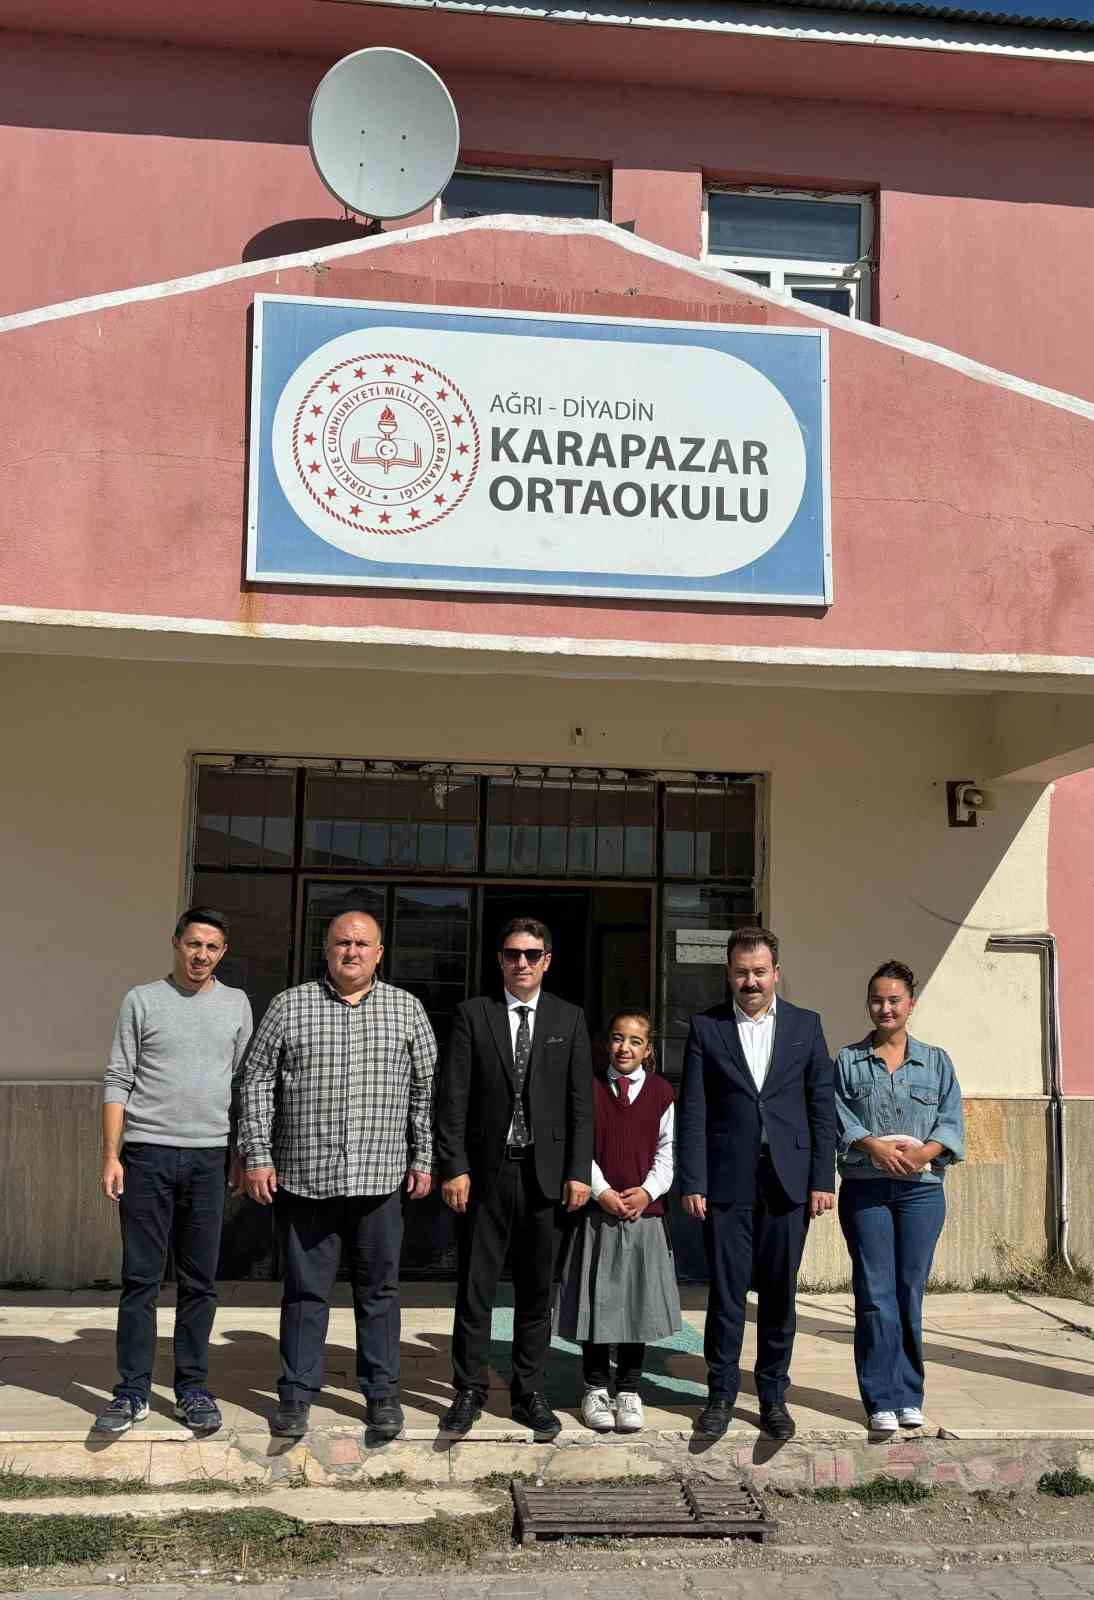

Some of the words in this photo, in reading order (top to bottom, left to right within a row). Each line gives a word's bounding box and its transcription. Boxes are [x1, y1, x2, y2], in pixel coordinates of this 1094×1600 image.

[384, 386, 420, 404] MİLLİ
[489, 392, 542, 415] AĞRI
[563, 396, 654, 421] DİYADİN
[327, 386, 381, 453] CUMHURİYETİ
[419, 402, 446, 443] EĞİTİM
[399, 447, 446, 500] BAKANLIĞI
[491, 426, 769, 476] KARAPAZAR
[330, 456, 373, 499] TÜRKİYE
[489, 475, 769, 523] ORTAOKULU
